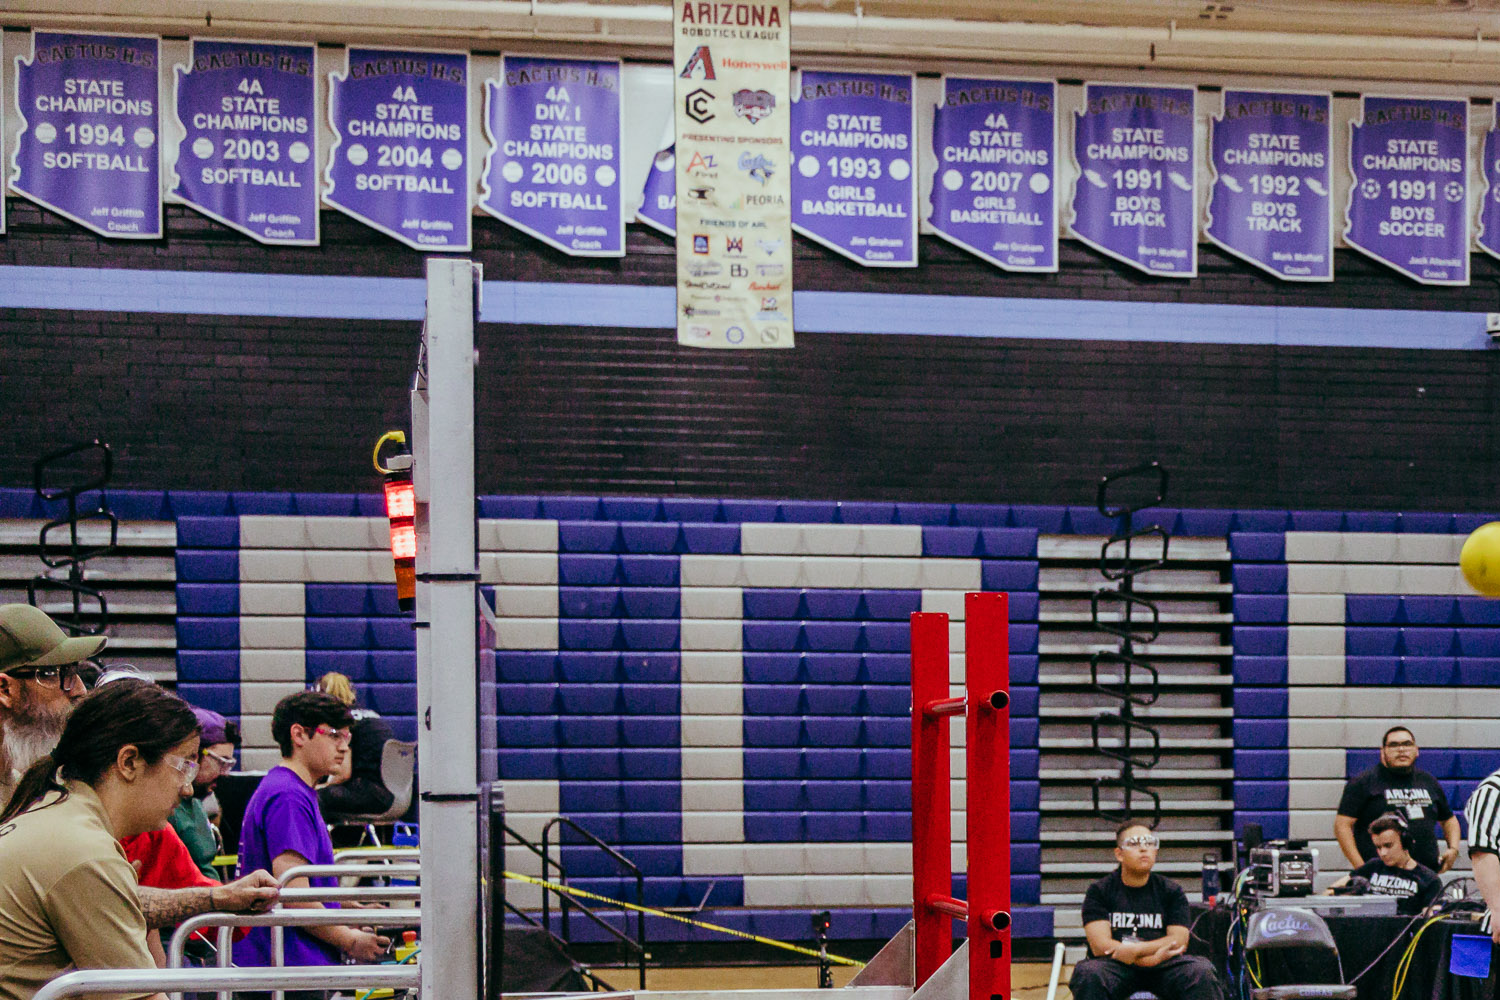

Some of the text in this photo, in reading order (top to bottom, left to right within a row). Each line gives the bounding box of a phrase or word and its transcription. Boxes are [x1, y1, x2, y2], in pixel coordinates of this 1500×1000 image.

[681, 3, 781, 28] ARIZONA
[682, 28, 780, 40] ROBOTICS LEAGUE
[37, 44, 120, 65] CACTUS
[722, 58, 788, 72] Honeywell
[65, 79, 124, 97] STATE
[238, 78, 263, 95] 4A
[392, 86, 417, 103] 4A
[546, 86, 570, 103] 4A
[802, 79, 873, 100] CACTUS
[36, 95, 152, 116] CHAMPIONS
[222, 96, 280, 115] STATE
[376, 104, 433, 122] STATE
[536, 104, 570, 121] DIV.
[193, 113, 308, 133] CHAMPIONS
[827, 114, 881, 132] STATE
[985, 113, 1008, 129] 4A
[65, 123, 125, 146] 1994
[348, 120, 461, 141] CHAMPIONS
[531, 124, 586, 142] STATE
[800, 130, 908, 149] CHAMPIONS
[969, 130, 1023, 148] STATE
[1112, 128, 1164, 144] STATE
[224, 139, 280, 162] 2003
[502, 140, 613, 160] CHAMPIONS
[1248, 133, 1300, 150] STATE
[1387, 139, 1438, 155] STATE
[43, 152, 149, 172] SOFTBALL
[378, 145, 433, 168] 2004
[943, 146, 1048, 165] CHAMPIONS
[1087, 144, 1189, 162] CHAMPIONS
[1224, 149, 1324, 168] CHAMPIONS
[827, 157, 881, 179] 1993
[1363, 154, 1462, 172] CHAMPIONS
[202, 168, 301, 187] SOFTBALL
[532, 163, 587, 185] 2006
[971, 171, 1023, 192] 2007
[1113, 168, 1161, 190] 1991
[356, 174, 454, 194] SOFTBALL
[827, 185, 875, 201] GIRLS
[1249, 174, 1299, 196] 1992
[1388, 180, 1436, 200] 1991
[511, 191, 608, 210] SOFTBALL
[746, 195, 784, 206] PEORIA
[802, 200, 907, 218] BASKETBALL
[974, 196, 1016, 210] GIRLS
[1116, 196, 1161, 211] BOYS
[1251, 201, 1296, 217] BOYS
[950, 210, 1043, 225] BASKETBALL
[1110, 211, 1165, 227] TRACK
[1390, 206, 1435, 221] BOYS
[1245, 216, 1301, 232] TRACK
[1379, 221, 1445, 238] SOCCER
[1109, 912, 1162, 929] RIZONA
[1260, 912, 1313, 938] Cactus
